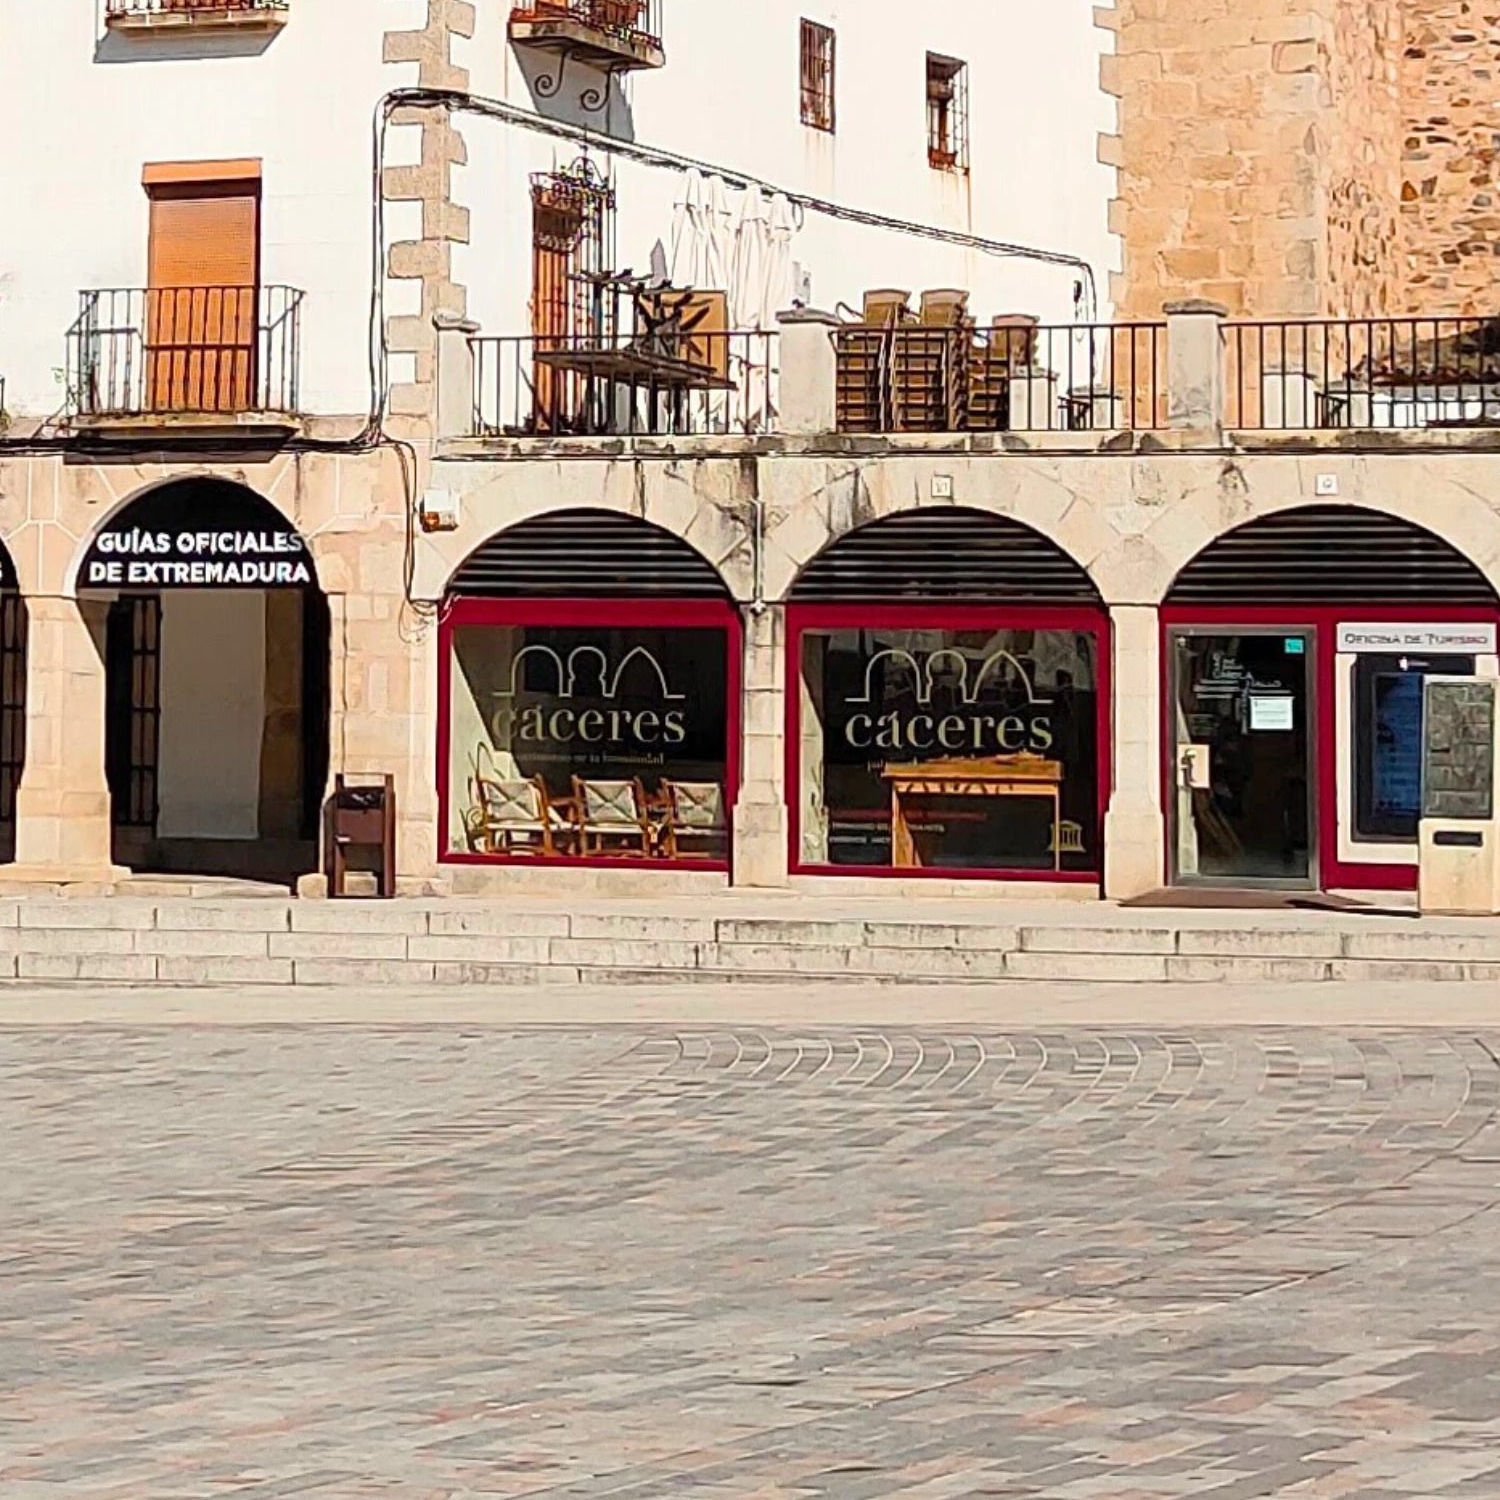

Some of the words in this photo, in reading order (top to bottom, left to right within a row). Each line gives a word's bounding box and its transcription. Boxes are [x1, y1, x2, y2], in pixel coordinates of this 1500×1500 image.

[97, 527, 171, 554] GUÍAS
[176, 531, 303, 554] OFICIALES
[89, 561, 123, 583] DE
[128, 561, 311, 583] EXTREMADURA
[845, 710, 1053, 749] cáceres
